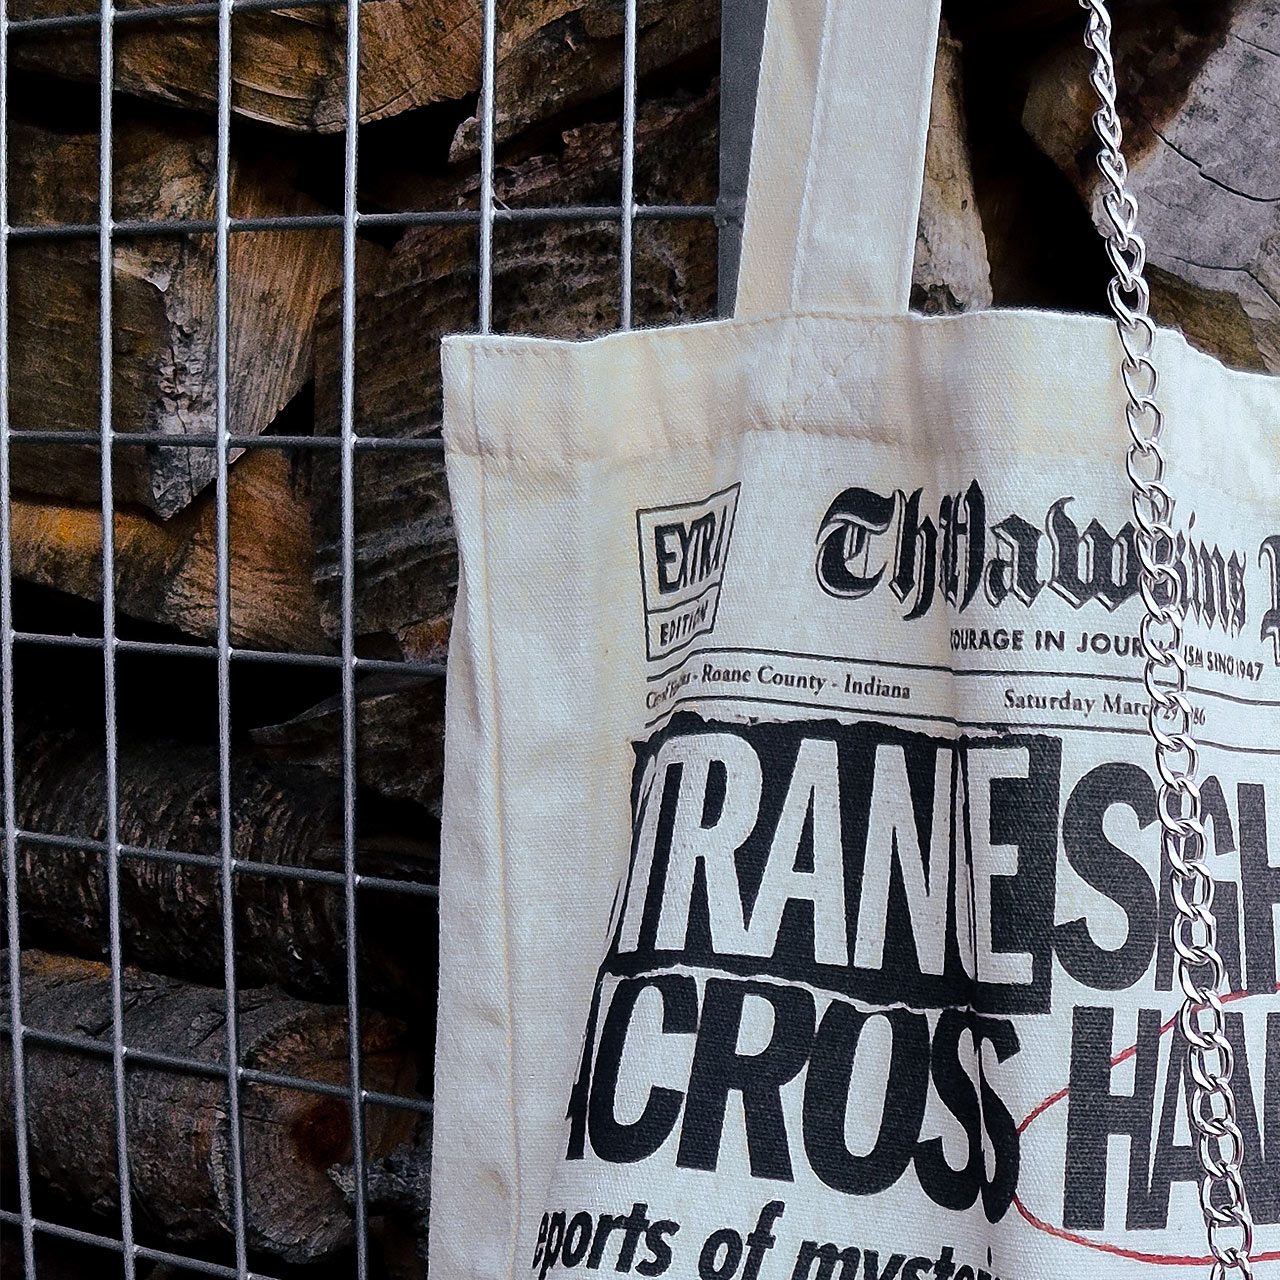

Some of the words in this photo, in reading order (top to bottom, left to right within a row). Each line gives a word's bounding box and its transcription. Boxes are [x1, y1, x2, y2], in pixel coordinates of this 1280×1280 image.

[951, 628, 1024, 651] OURAGE
[1035, 629, 1065, 651] IN
[702, 663, 751, 683] Roane
[757, 665, 827, 695] County
[844, 674, 911, 700] Indiana
[1003, 689, 1096, 718] Saturday
